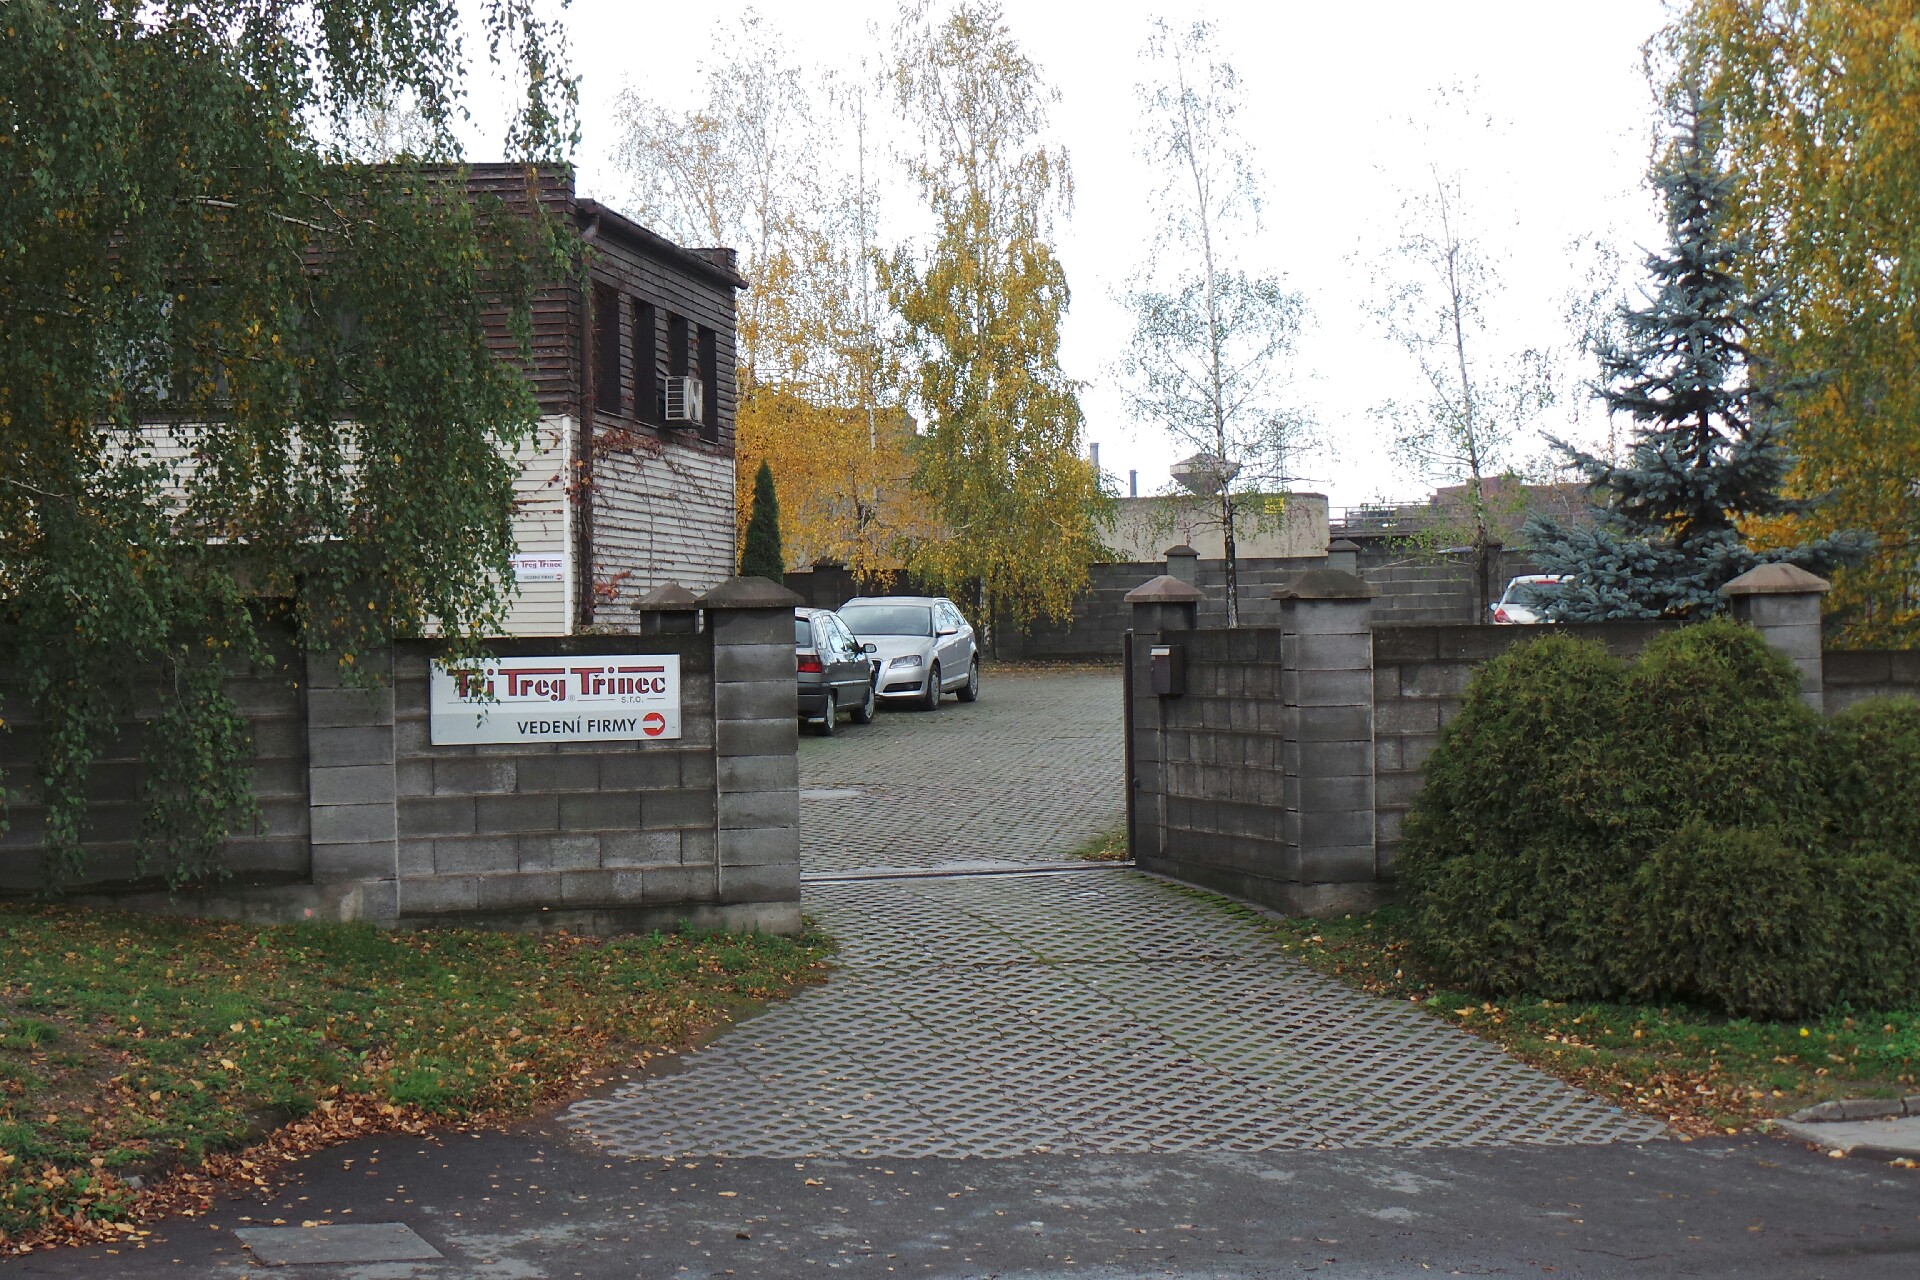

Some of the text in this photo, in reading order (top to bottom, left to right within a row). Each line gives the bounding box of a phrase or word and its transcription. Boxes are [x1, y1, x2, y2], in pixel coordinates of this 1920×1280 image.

[498, 667, 566, 702] Treg
[570, 665, 666, 695] Třinec
[621, 695, 644, 704] s.r.o.
[516, 715, 637, 735] VEDENÍ FIRMY
